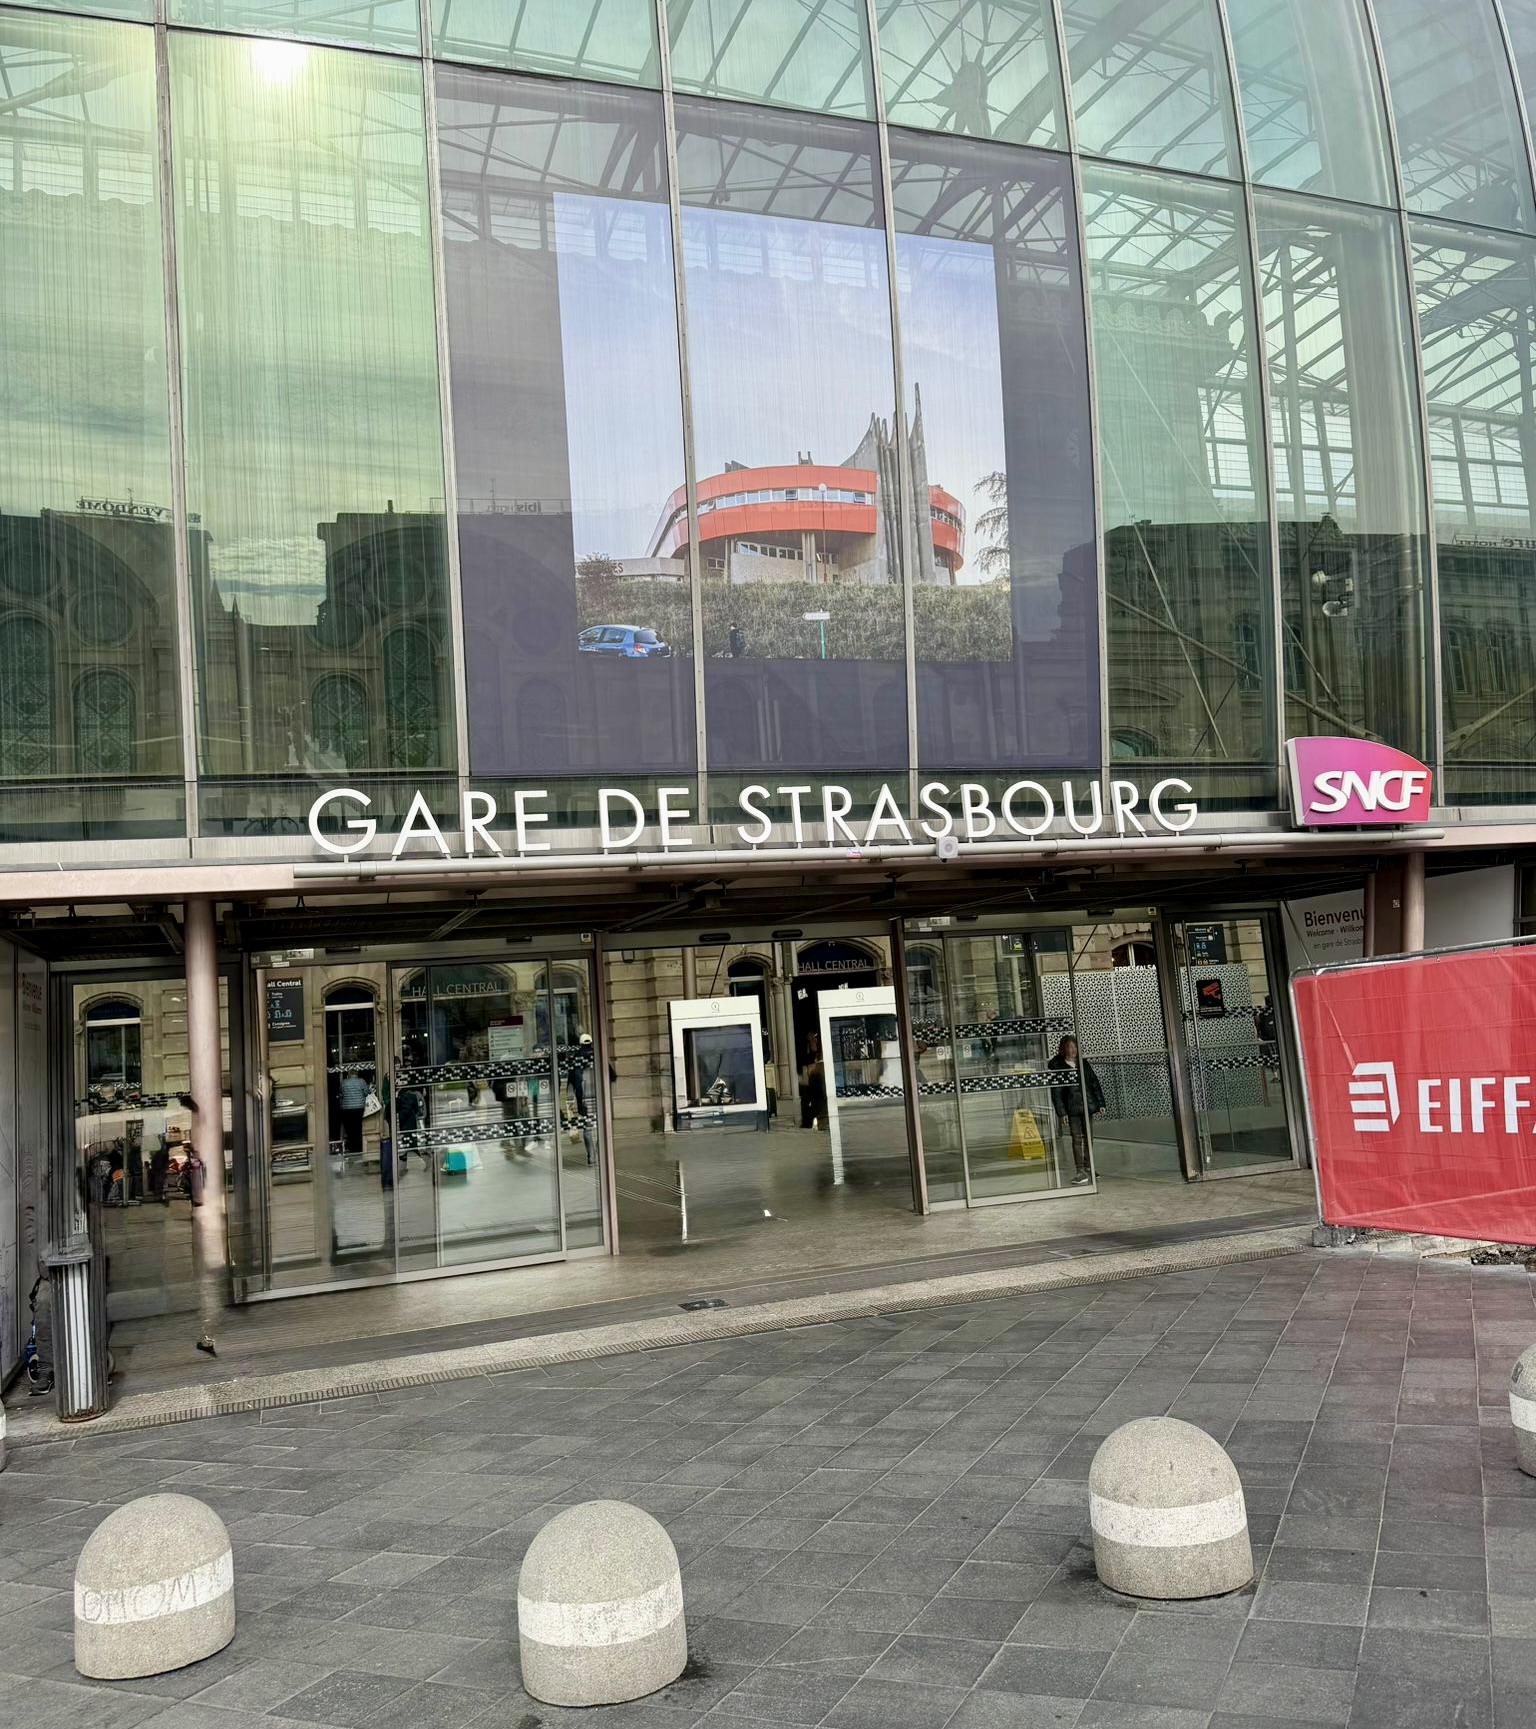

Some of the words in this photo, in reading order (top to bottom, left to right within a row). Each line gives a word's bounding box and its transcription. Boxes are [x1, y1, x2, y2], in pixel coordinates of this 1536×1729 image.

[1310, 769, 1428, 813] SNCF
[308, 788, 551, 856] GARE
[599, 787, 693, 848] DE
[737, 778, 1199, 844] STRASBOURG
[825, 959, 870, 971] CENTRAL
[446, 981, 502, 996] CENTRAL
[1417, 1076, 1536, 1134] EIFF
